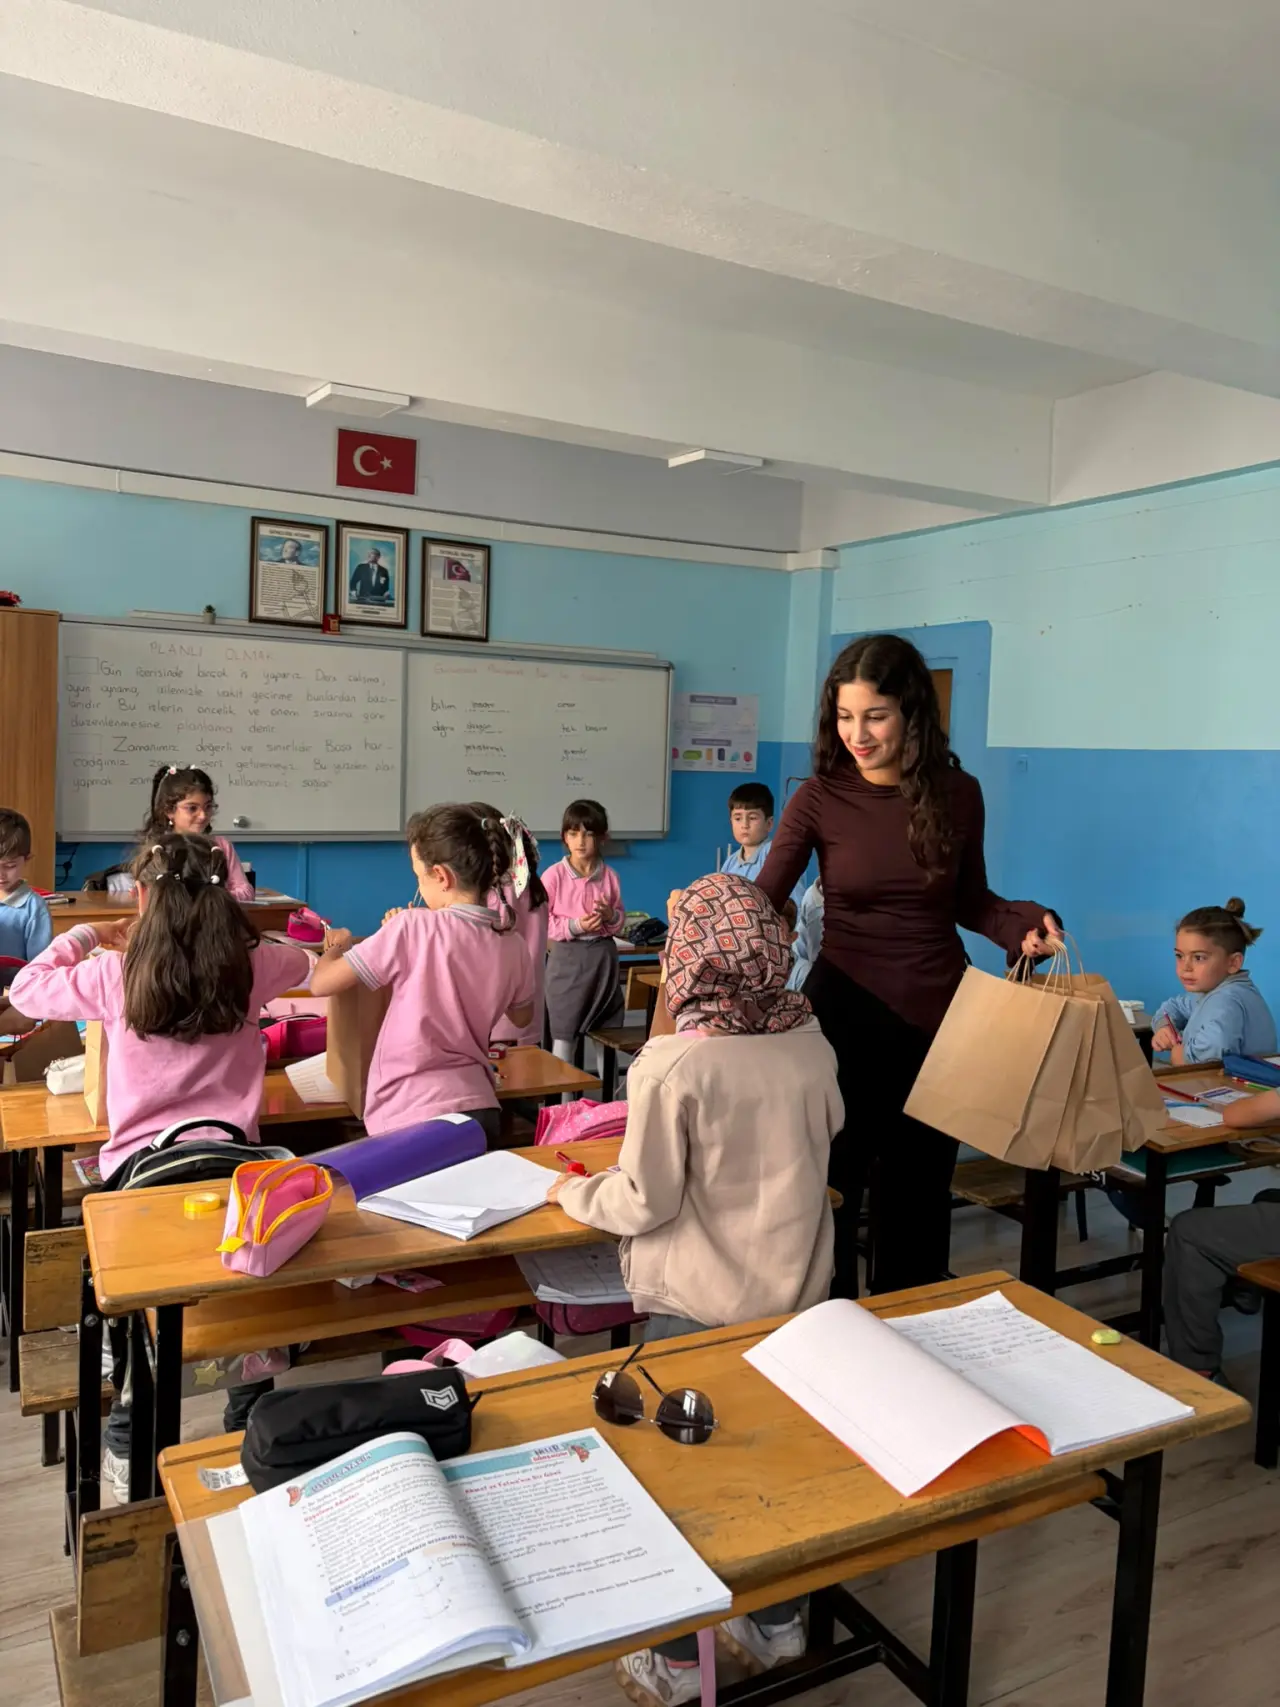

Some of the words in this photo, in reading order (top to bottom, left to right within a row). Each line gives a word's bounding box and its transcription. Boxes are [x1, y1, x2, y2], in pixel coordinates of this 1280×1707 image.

[150, 641, 203, 657] PLANLI
[66, 684, 90, 698] oyun
[157, 684, 204, 697] ailemizle
[217, 686, 243, 698] vakit
[306, 687, 356, 703] bunlardan
[118, 698, 136, 711] Bu
[248, 707, 260, 716] ve
[177, 718, 233, 734] planlama
[112, 736, 179, 752] Zamanımız
